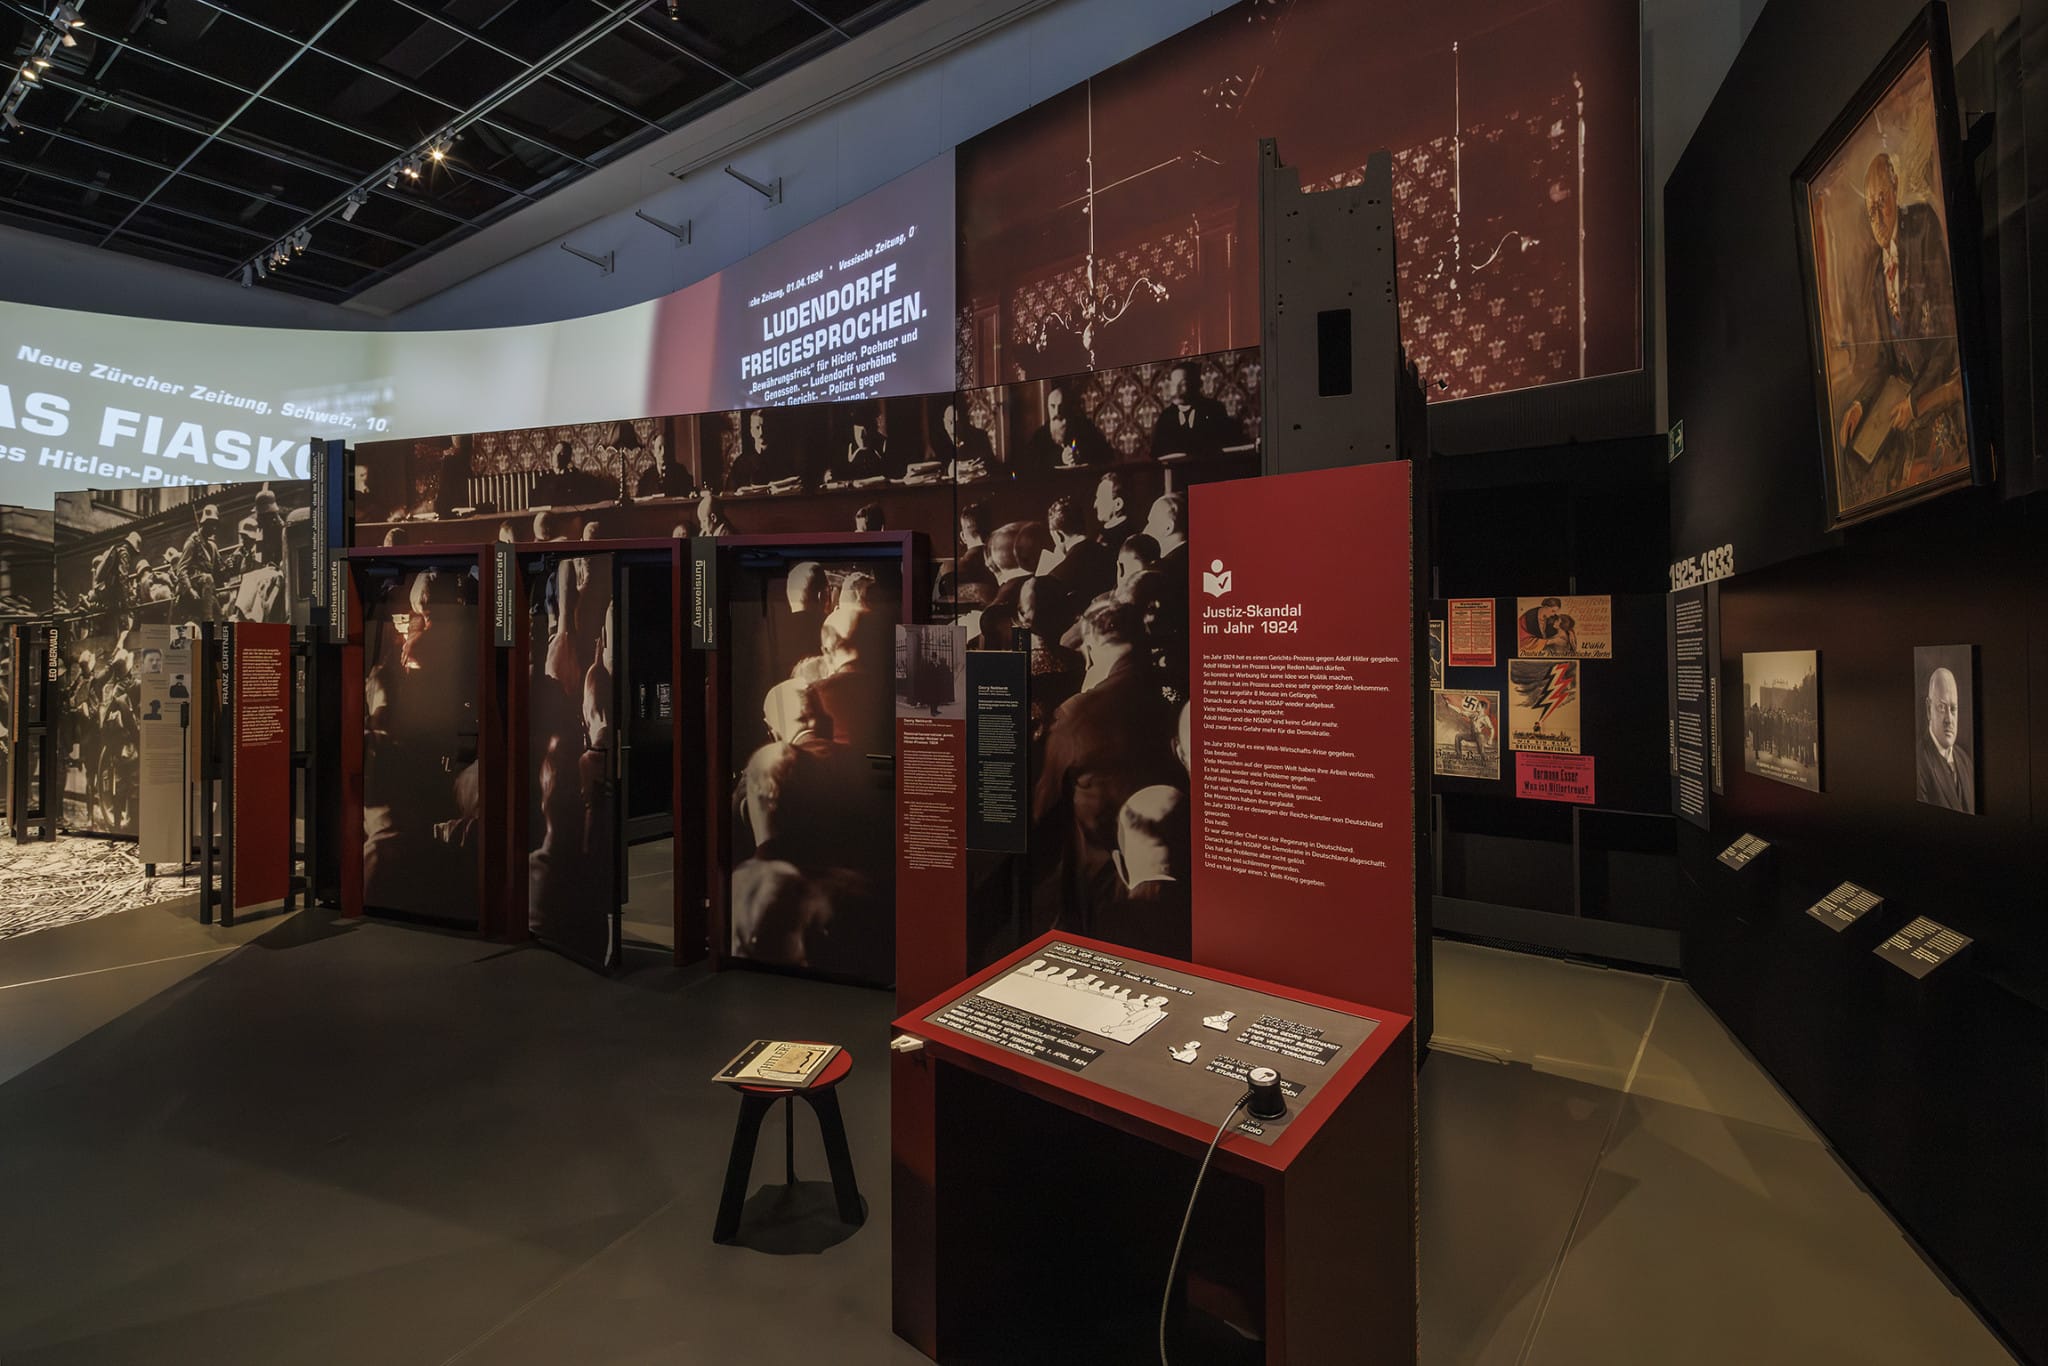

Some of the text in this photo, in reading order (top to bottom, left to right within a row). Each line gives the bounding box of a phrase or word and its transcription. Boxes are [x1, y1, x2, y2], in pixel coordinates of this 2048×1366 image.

[761, 288, 785, 304] Zeitung,
[786, 269, 824, 294] 01.04.1924
[839, 249, 874, 271] Vossische
[875, 236, 906, 255] Zeitung,
[763, 263, 897, 342] LUDENDORFF
[741, 291, 927, 380] FREIGESPROCHEN.
[816, 361, 830, 372] für
[831, 351, 858, 368] Hitler,
[860, 338, 899, 358] Poehner
[901, 328, 918, 343] und
[16, 345, 390, 433] Neue Zürcher Zeitung, Schweiz, 10.
[764, 352, 897, 401] Genossen. Ludendorff verhöhnt
[787, 391, 819, 406] Gericht.
[829, 378, 857, 395] Polizei
[859, 371, 885, 389] gegen
[330, 561, 338, 626] Höchststrafe
[693, 560, 703, 628] Ausweisung
[1203, 604, 1302, 618] Justiz-Skandal
[1203, 621, 1298, 634] im Jahr 1924
[49, 629, 57, 681] LEO BAERWALD
[1311, 850, 1348, 862] Deutschland
[1054, 945, 1123, 967] HITLER VOR GERICHT
[1179, 988, 1194, 996] 1924
[1250, 1034, 1265, 1042] DER
[1266, 1039, 1319, 1057] VERGANGENHEIT
[1251, 1023, 1341, 1051] RICHTER GEORG NEITHARDT
[1071, 1057, 1088, 1066] 1924
[1211, 1059, 1234, 1069] HITLER
[1249, 1040, 1279, 1053] RECHTEN
[1280, 1049, 1326, 1066] TERRORISTEN
[1238, 1123, 1263, 1135] AUDIO
